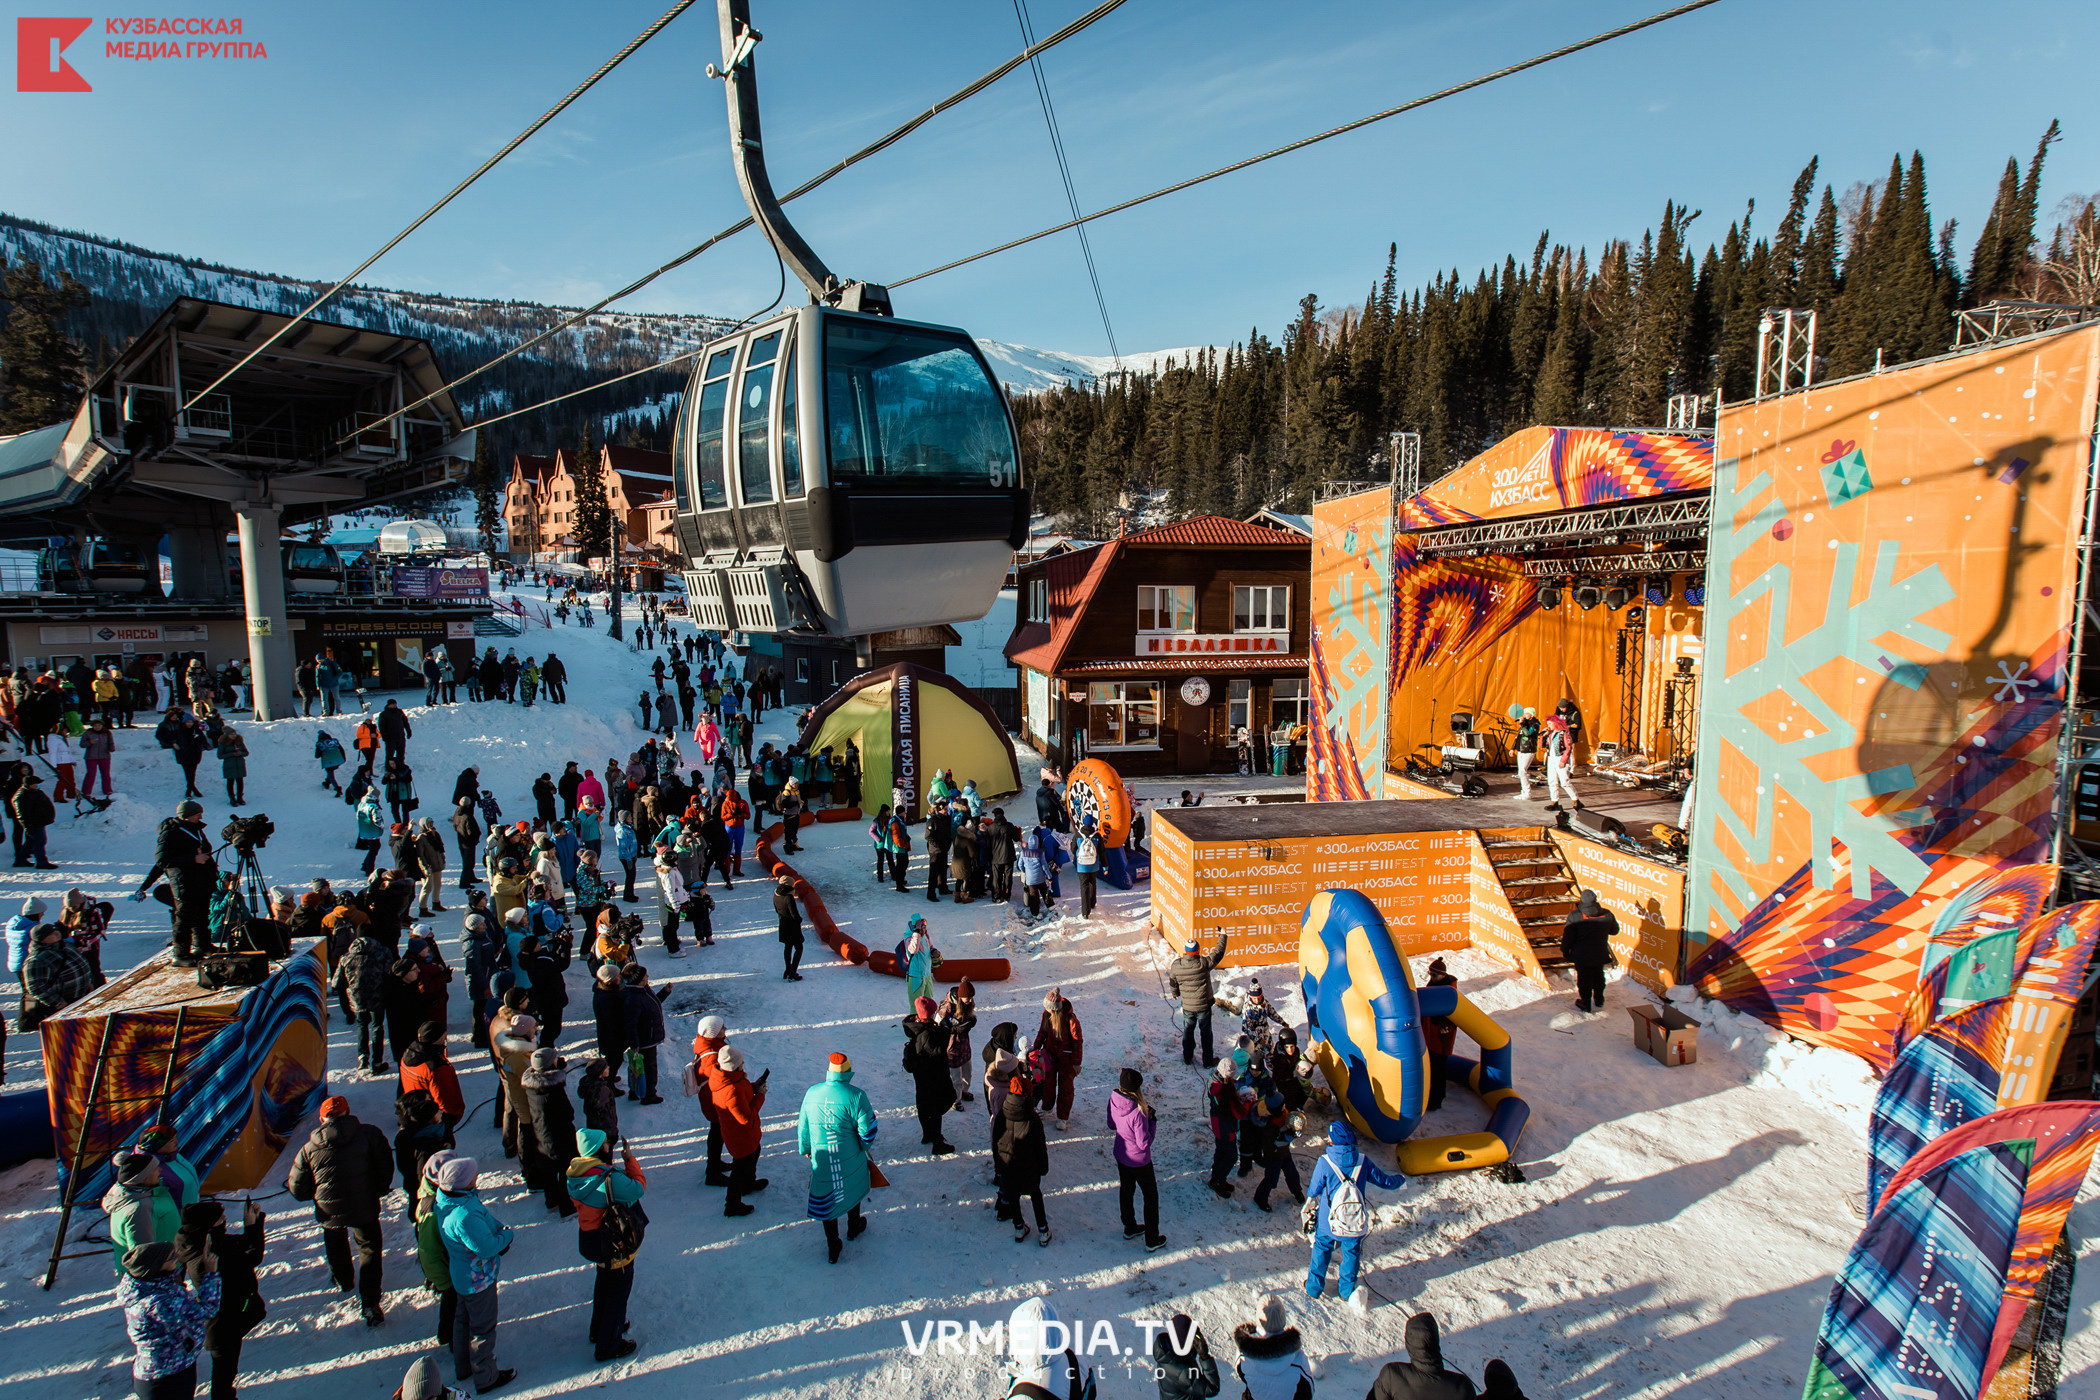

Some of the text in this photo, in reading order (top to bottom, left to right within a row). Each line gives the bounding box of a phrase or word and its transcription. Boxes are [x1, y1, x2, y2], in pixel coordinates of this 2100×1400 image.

[989, 461, 1013, 487] 51
[1492, 466, 1518, 488] 300
[1490, 480, 1551, 508] КУЗБАСС
[450, 577, 482, 585] BELKA
[117, 628, 159, 640] КАССЫ
[1149, 638, 1278, 652] НЕВАЛЯШКА
[898, 674, 916, 807] ТОМСКАЯ ПИСАНИЦА
[1080, 766, 1088, 774] 20
[1102, 799, 1111, 811] 13
